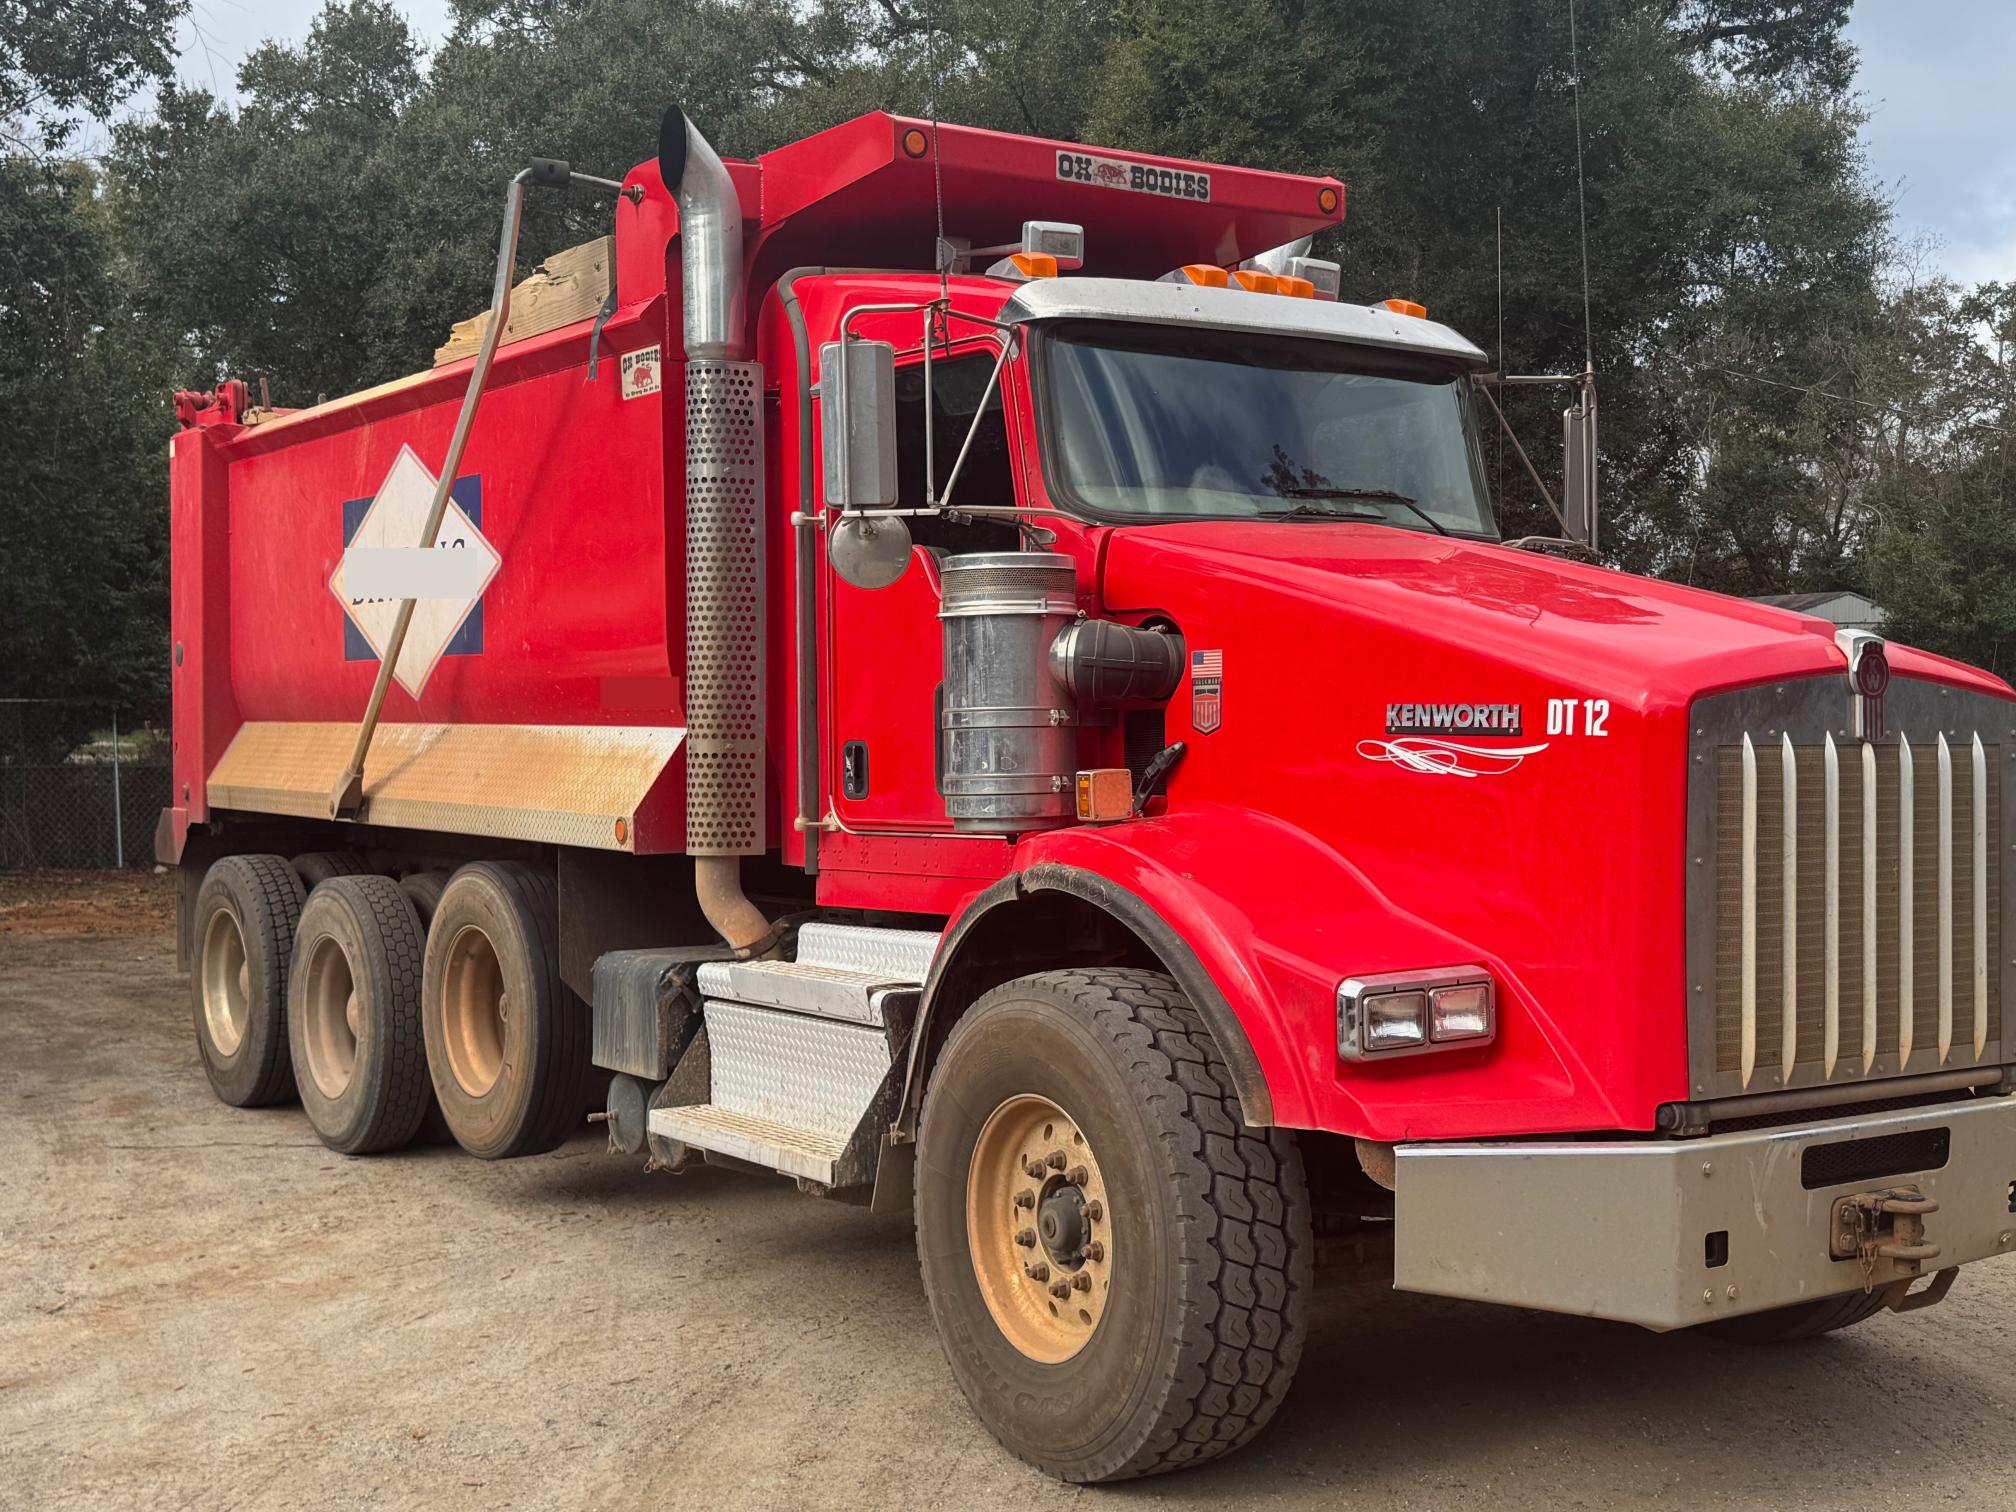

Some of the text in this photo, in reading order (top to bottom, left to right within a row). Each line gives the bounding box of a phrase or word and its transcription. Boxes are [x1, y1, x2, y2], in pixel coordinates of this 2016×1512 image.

[1058, 154, 1209, 199] OX BODIES
[1386, 703, 1520, 729] KENWORTH
[1547, 699, 1609, 736] DT 12
